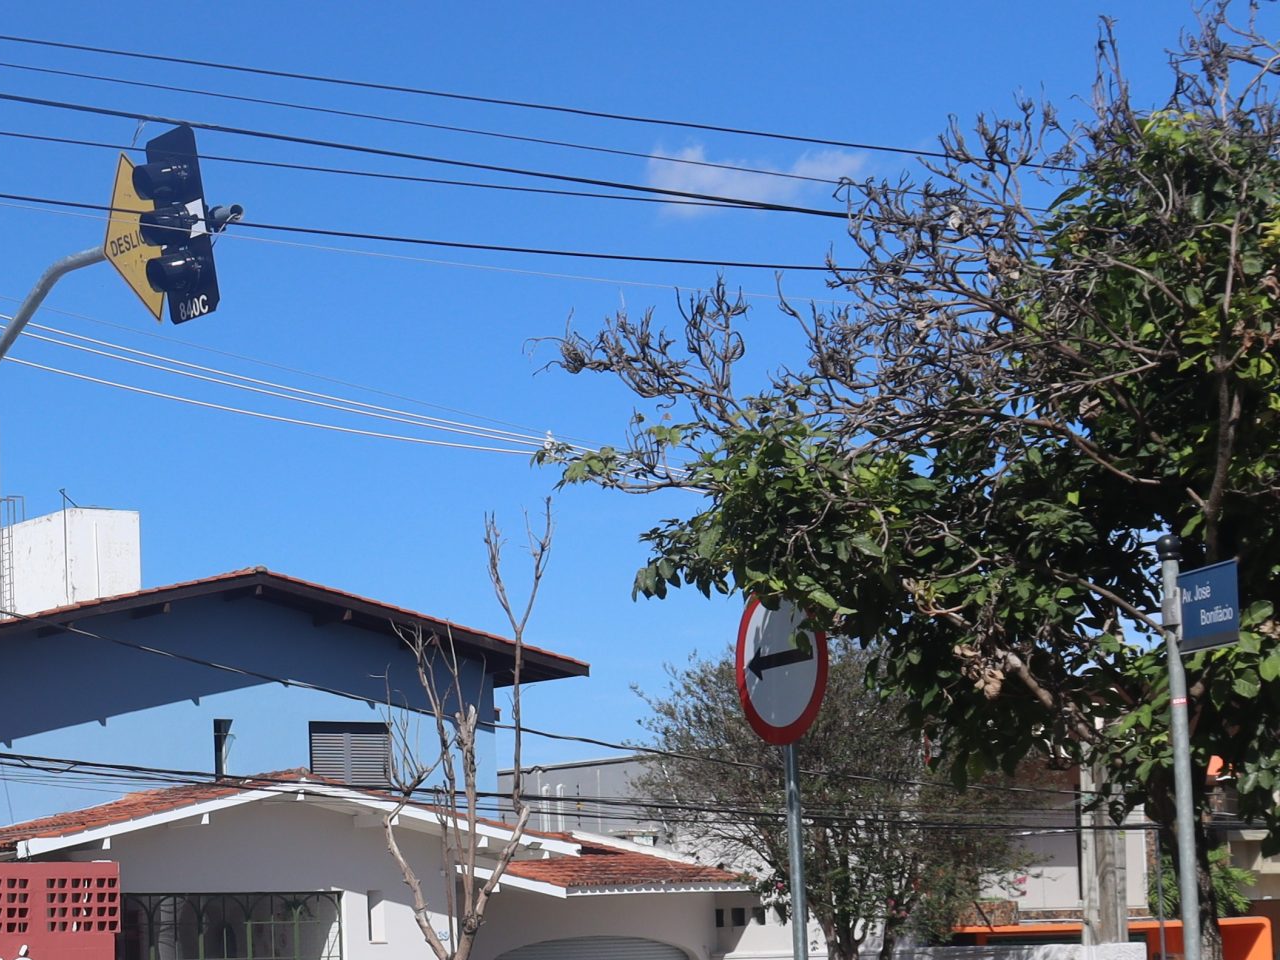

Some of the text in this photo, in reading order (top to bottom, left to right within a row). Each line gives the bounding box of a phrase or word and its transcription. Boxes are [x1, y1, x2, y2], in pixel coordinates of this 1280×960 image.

[109, 229, 147, 258] DESLI
[1182, 581, 1211, 604] Av. José
[1200, 604, 1234, 626] Bonifácio
